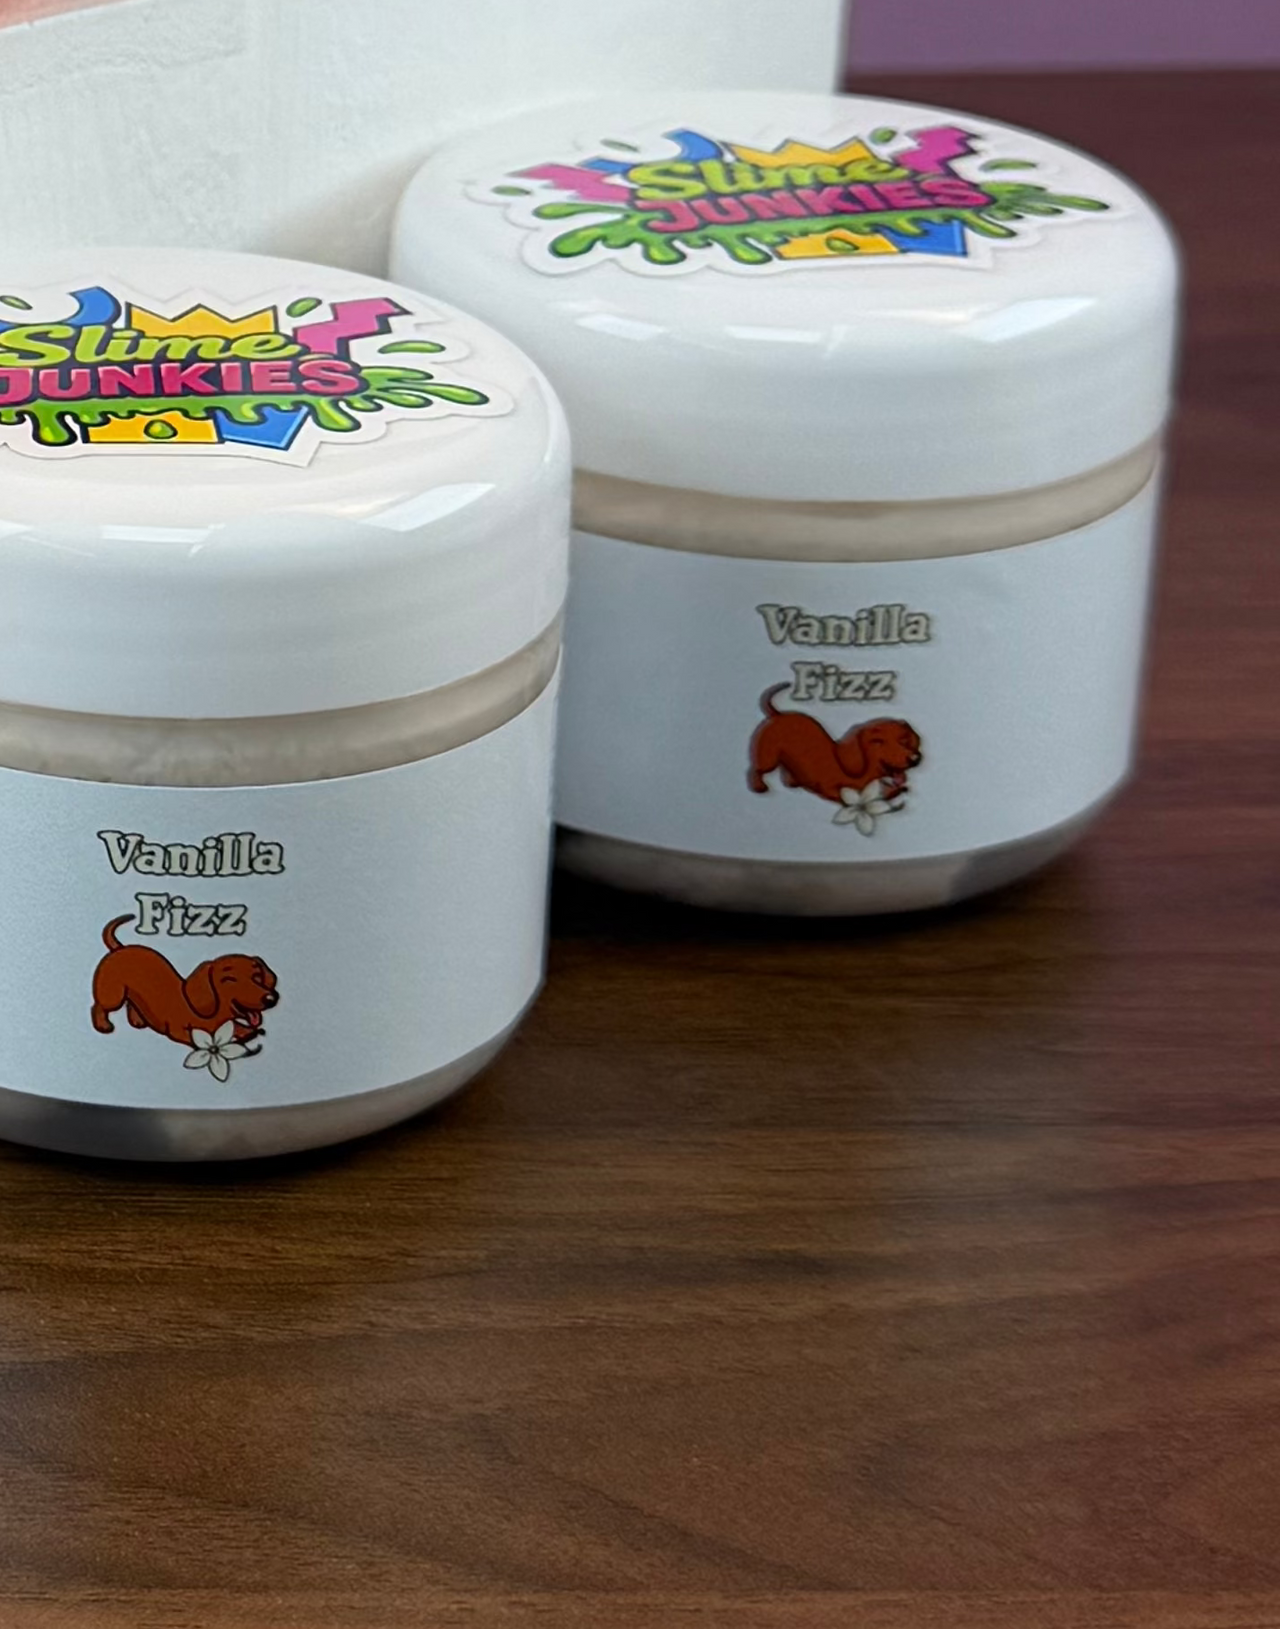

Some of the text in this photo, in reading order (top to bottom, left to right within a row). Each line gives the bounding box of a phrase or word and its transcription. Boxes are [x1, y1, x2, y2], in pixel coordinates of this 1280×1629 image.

[628, 159, 910, 201] Slime
[637, 178, 990, 233] JUNKIES
[755, 603, 932, 647] Vanilla
[790, 660, 897, 702] Fizz
[97, 830, 285, 878] Vanilla
[135, 892, 248, 937] Fizz
